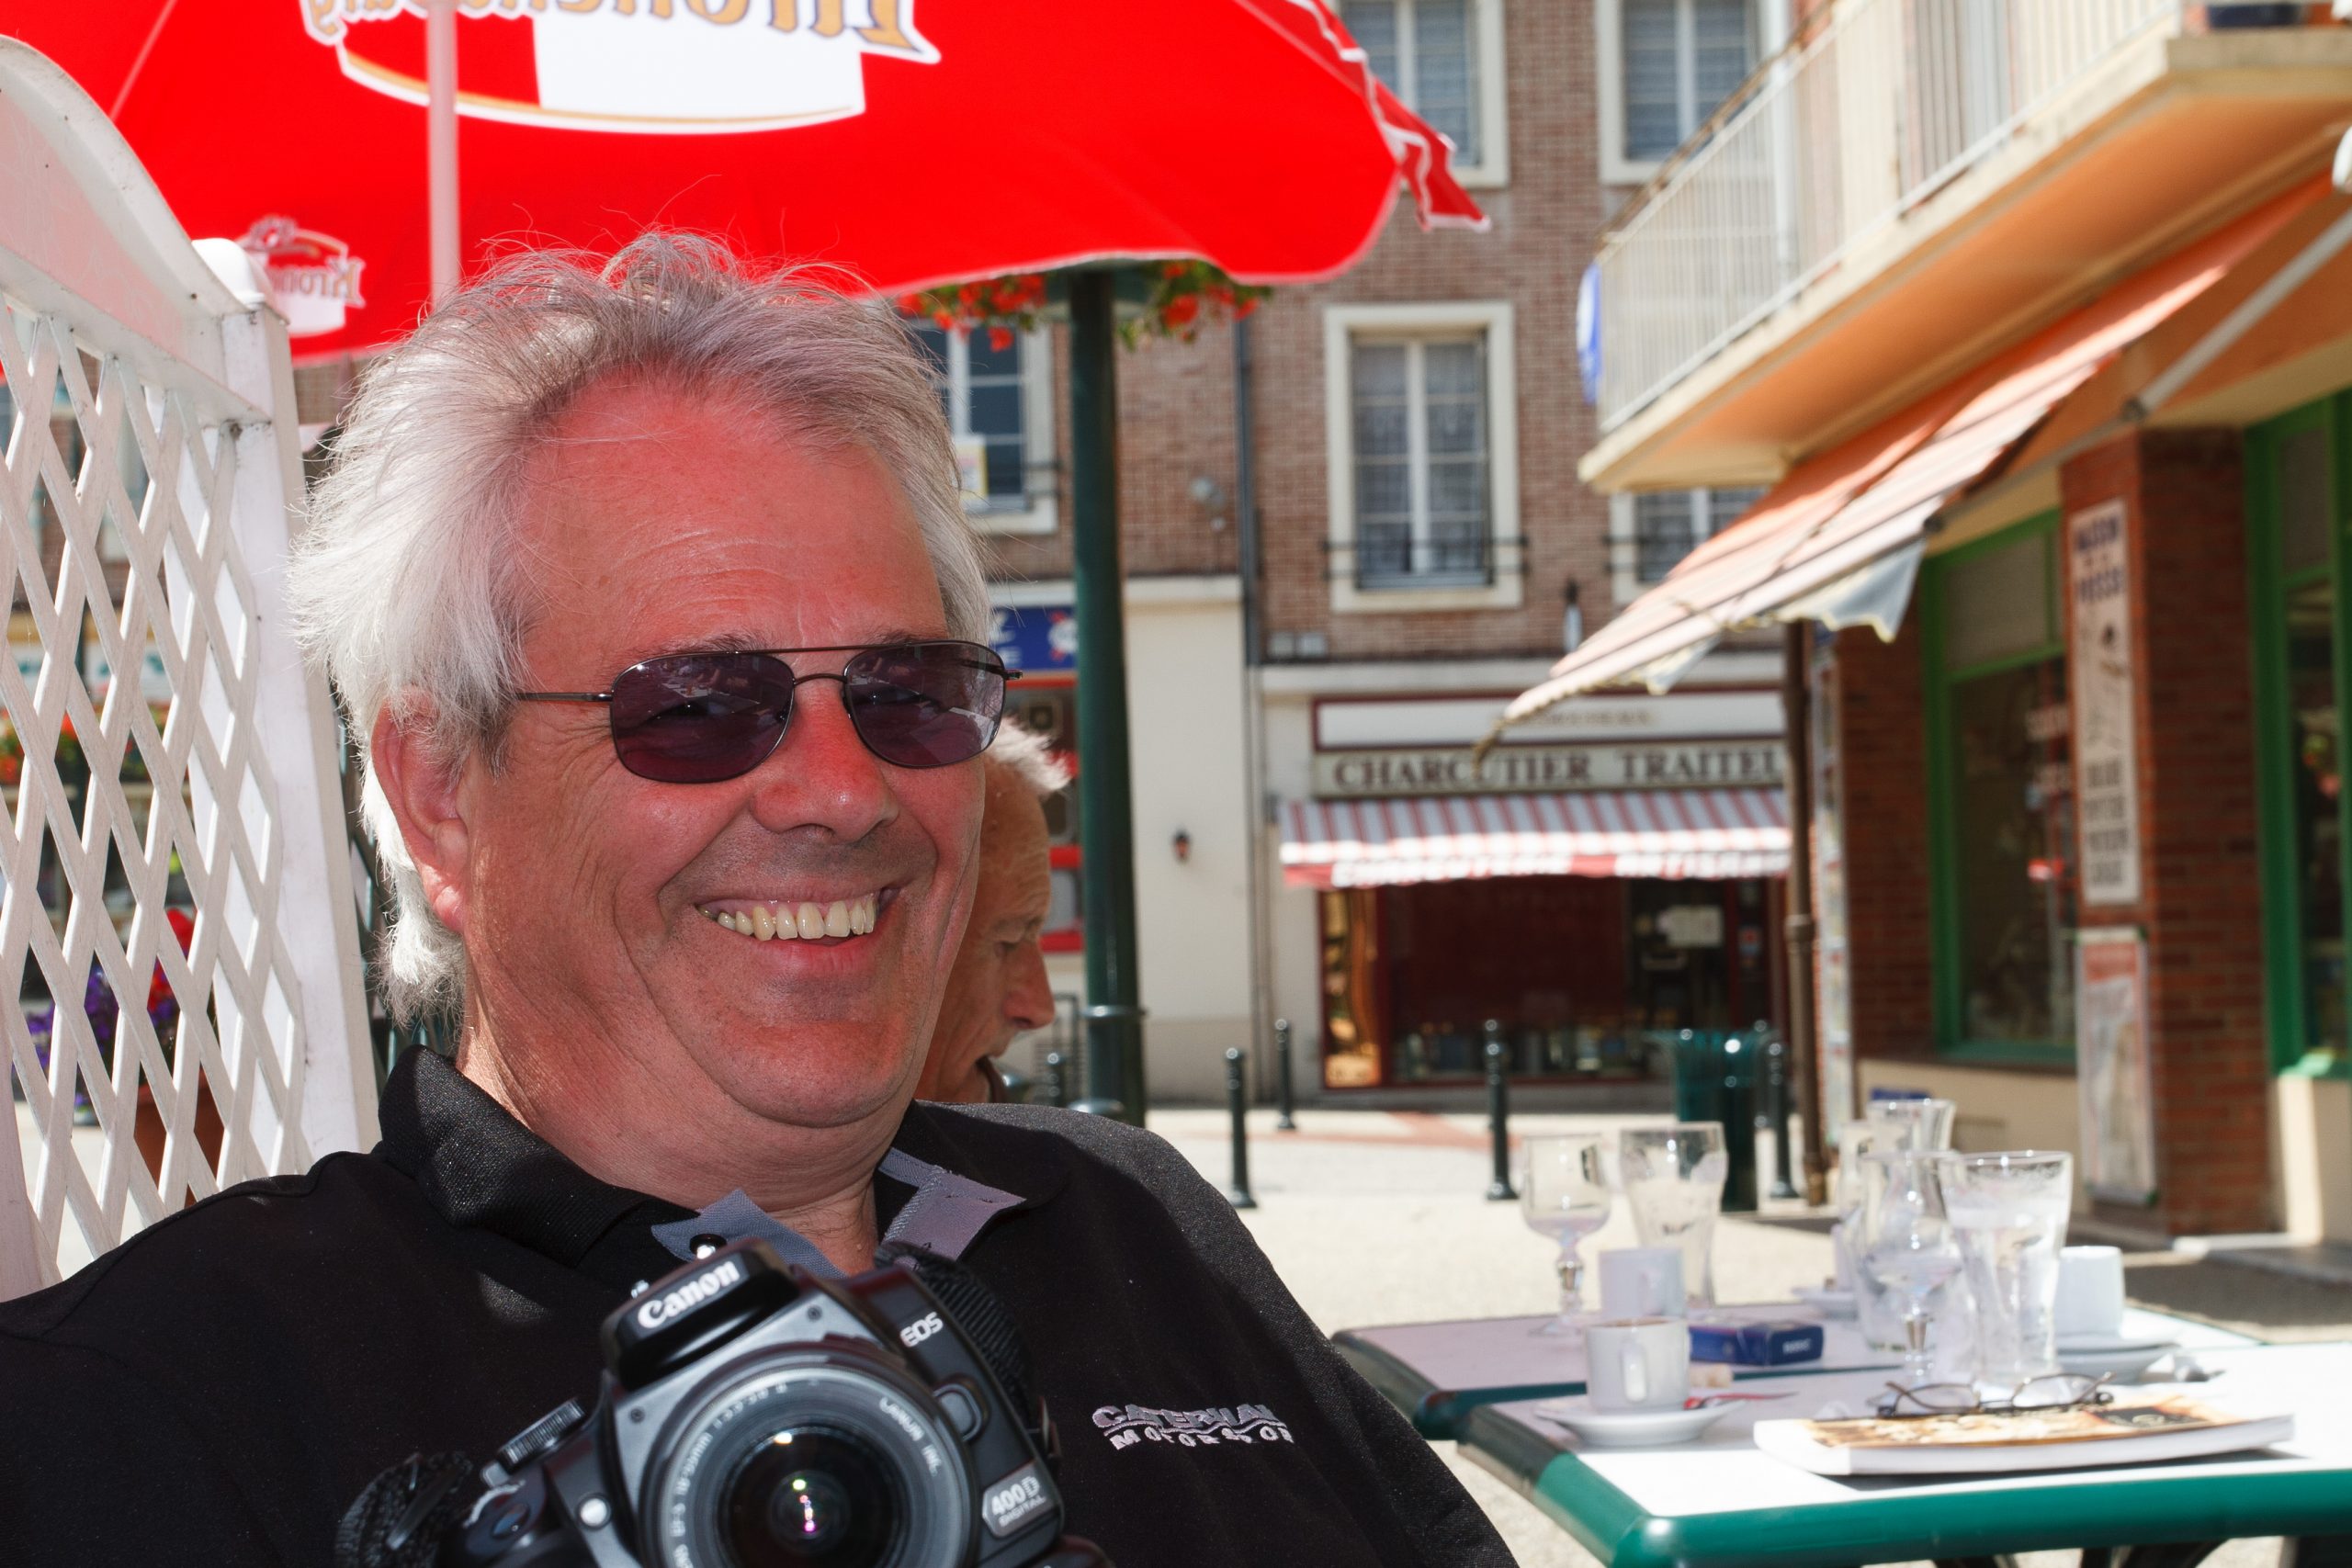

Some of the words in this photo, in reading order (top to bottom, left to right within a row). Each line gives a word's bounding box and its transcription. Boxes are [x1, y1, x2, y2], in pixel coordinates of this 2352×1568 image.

[1334, 751, 1590, 791] CHARCUTIER
[1615, 747, 1784, 782] TRAITEU
[638, 1260, 741, 1329] Canon
[899, 1311, 944, 1348] EOS
[991, 1475, 1040, 1516] 400D
